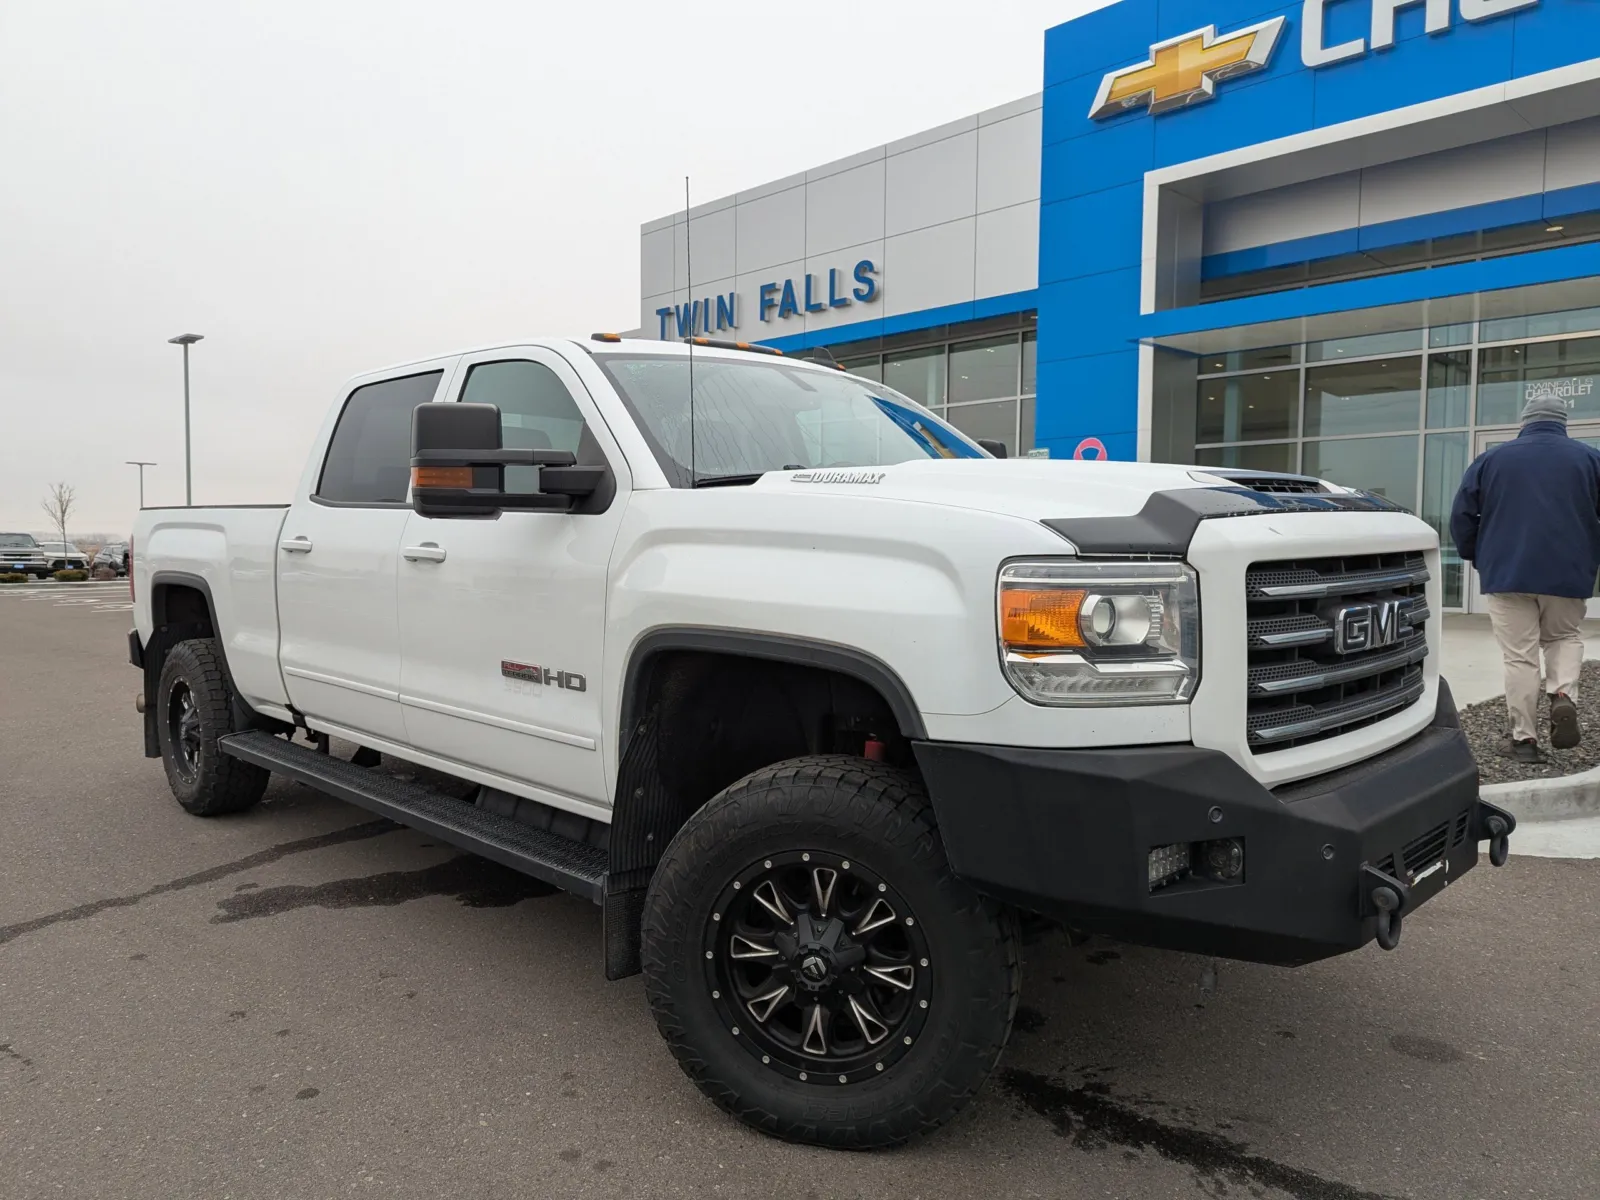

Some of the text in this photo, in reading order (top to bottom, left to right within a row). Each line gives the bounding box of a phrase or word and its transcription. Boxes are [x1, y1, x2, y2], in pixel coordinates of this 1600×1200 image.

[656, 260, 876, 341] TWIN FALLS
[810, 472, 886, 485] DURAMAX
[1335, 600, 1414, 656] GMC
[543, 667, 586, 692] HD
